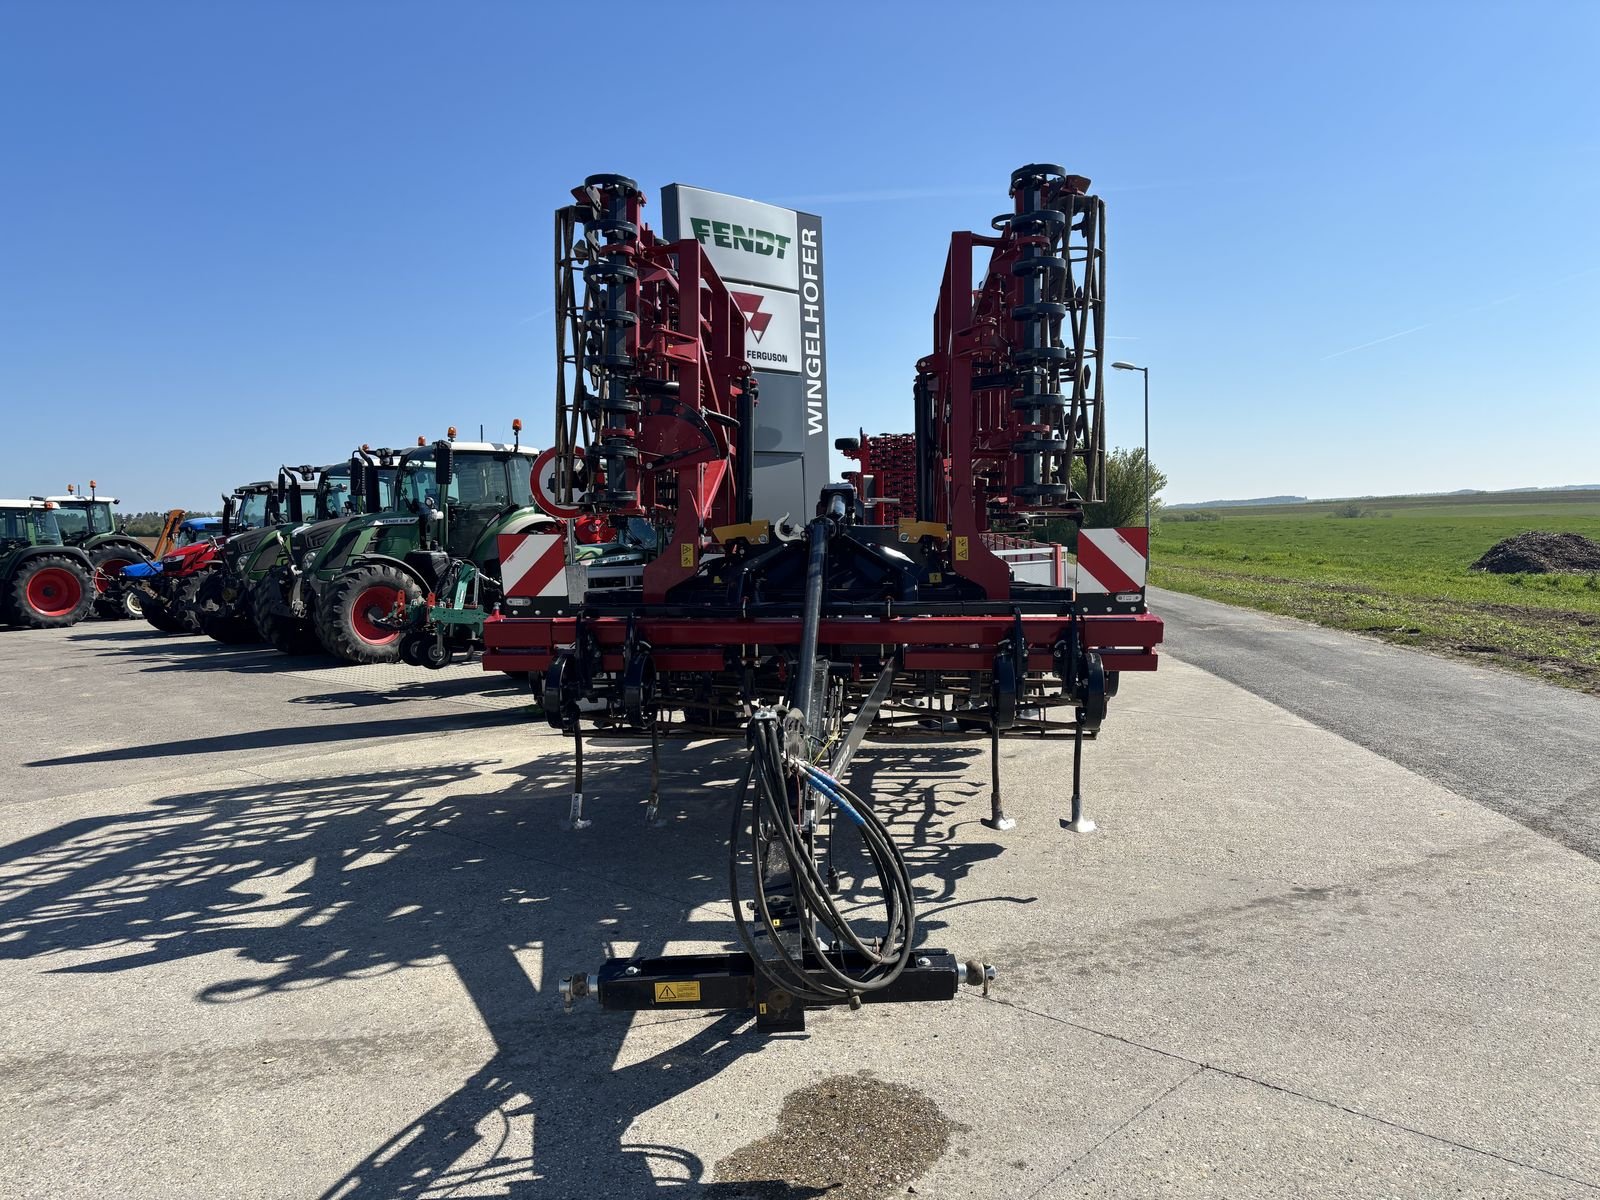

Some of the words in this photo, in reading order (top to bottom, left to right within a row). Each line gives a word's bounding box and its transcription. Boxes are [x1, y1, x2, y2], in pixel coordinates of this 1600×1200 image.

[690, 217, 791, 260] FENDT
[801, 228, 823, 435] WINGELHOFER
[746, 350, 788, 363] FERGUSON
